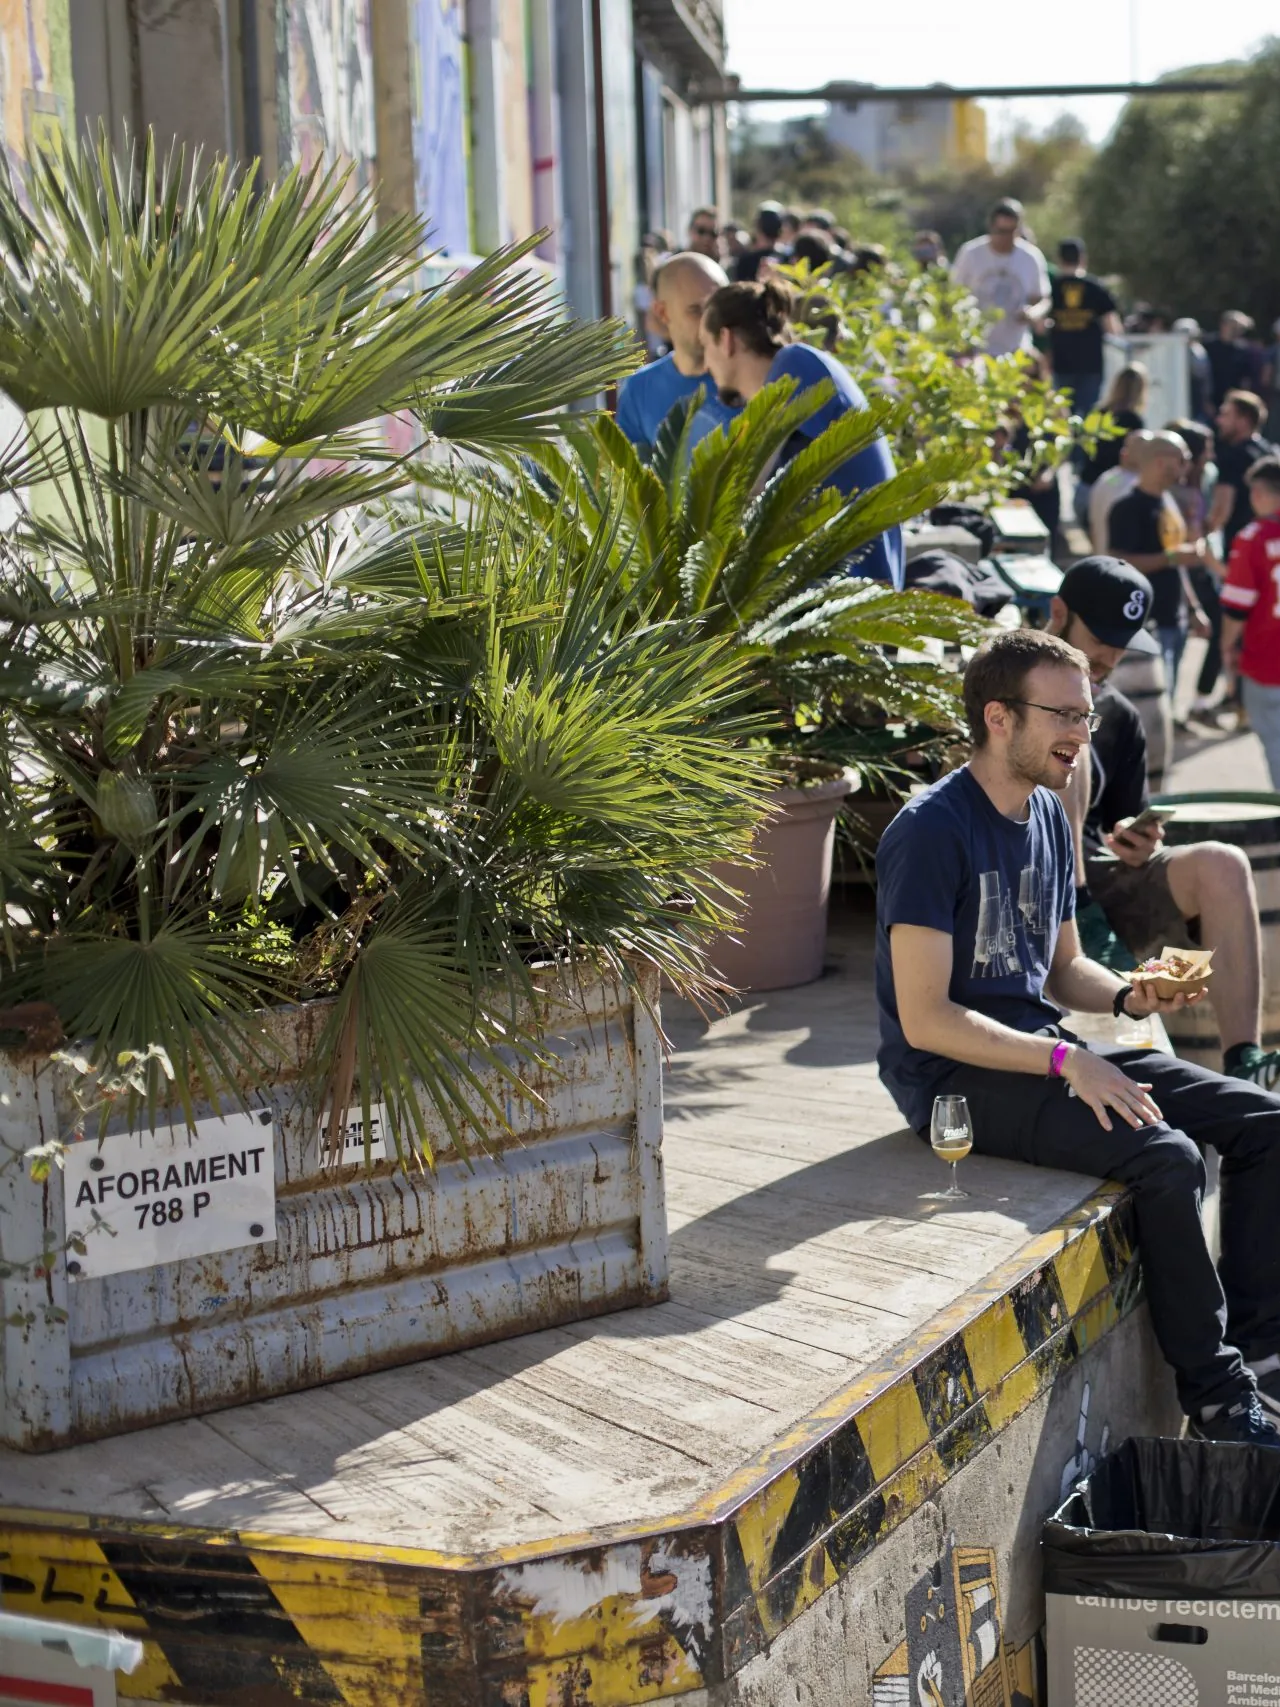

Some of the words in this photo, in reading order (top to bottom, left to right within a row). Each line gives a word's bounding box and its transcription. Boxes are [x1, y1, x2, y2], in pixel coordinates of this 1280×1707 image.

[943, 1124, 969, 1138] mash
[75, 1148, 265, 1208] AFORAMENT
[134, 1197, 184, 1230] 788
[193, 1191, 211, 1218] P
[1227, 1684, 1247, 1695] pel
